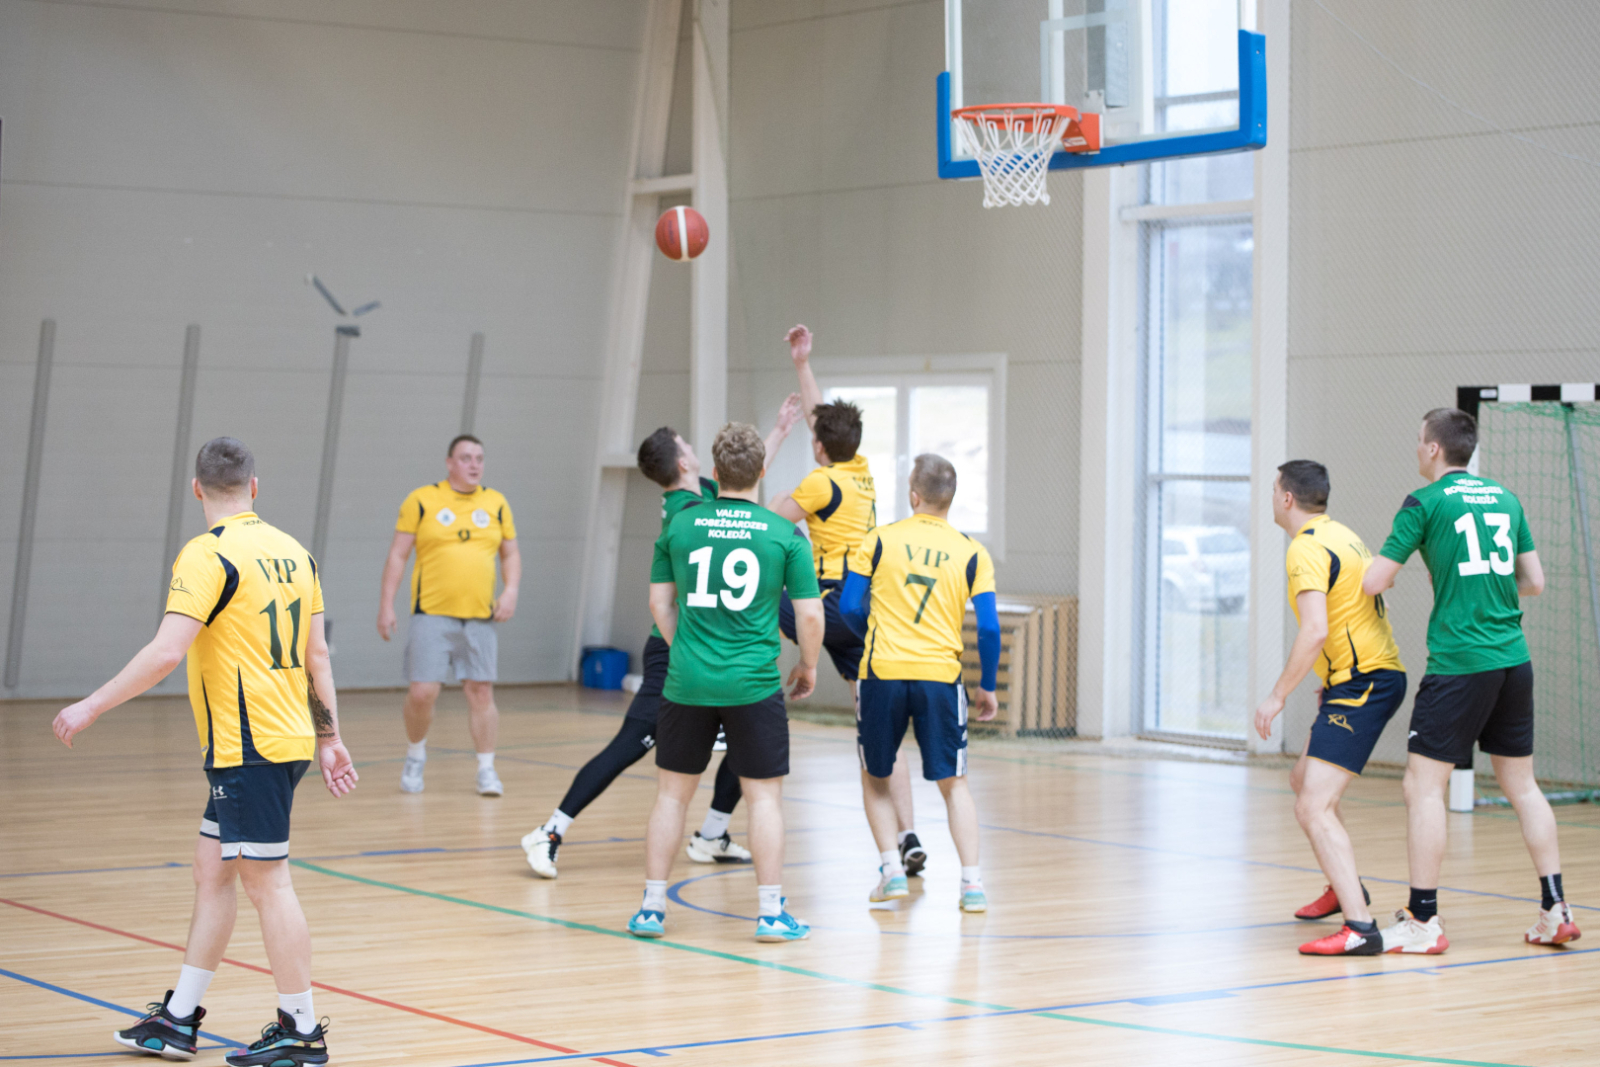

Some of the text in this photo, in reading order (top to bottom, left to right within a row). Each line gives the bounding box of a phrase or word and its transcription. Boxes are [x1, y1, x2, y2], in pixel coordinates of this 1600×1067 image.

[694, 517, 769, 531] ROBEŽSARDZES
[715, 508, 752, 519] VALSTS
[707, 528, 752, 540] KOLEDŽA
[1453, 512, 1515, 577] 13
[904, 543, 950, 569] VIP
[255, 558, 298, 584] VIP
[686, 546, 761, 612] 19
[903, 573, 938, 624] 7
[259, 597, 304, 671] 11
